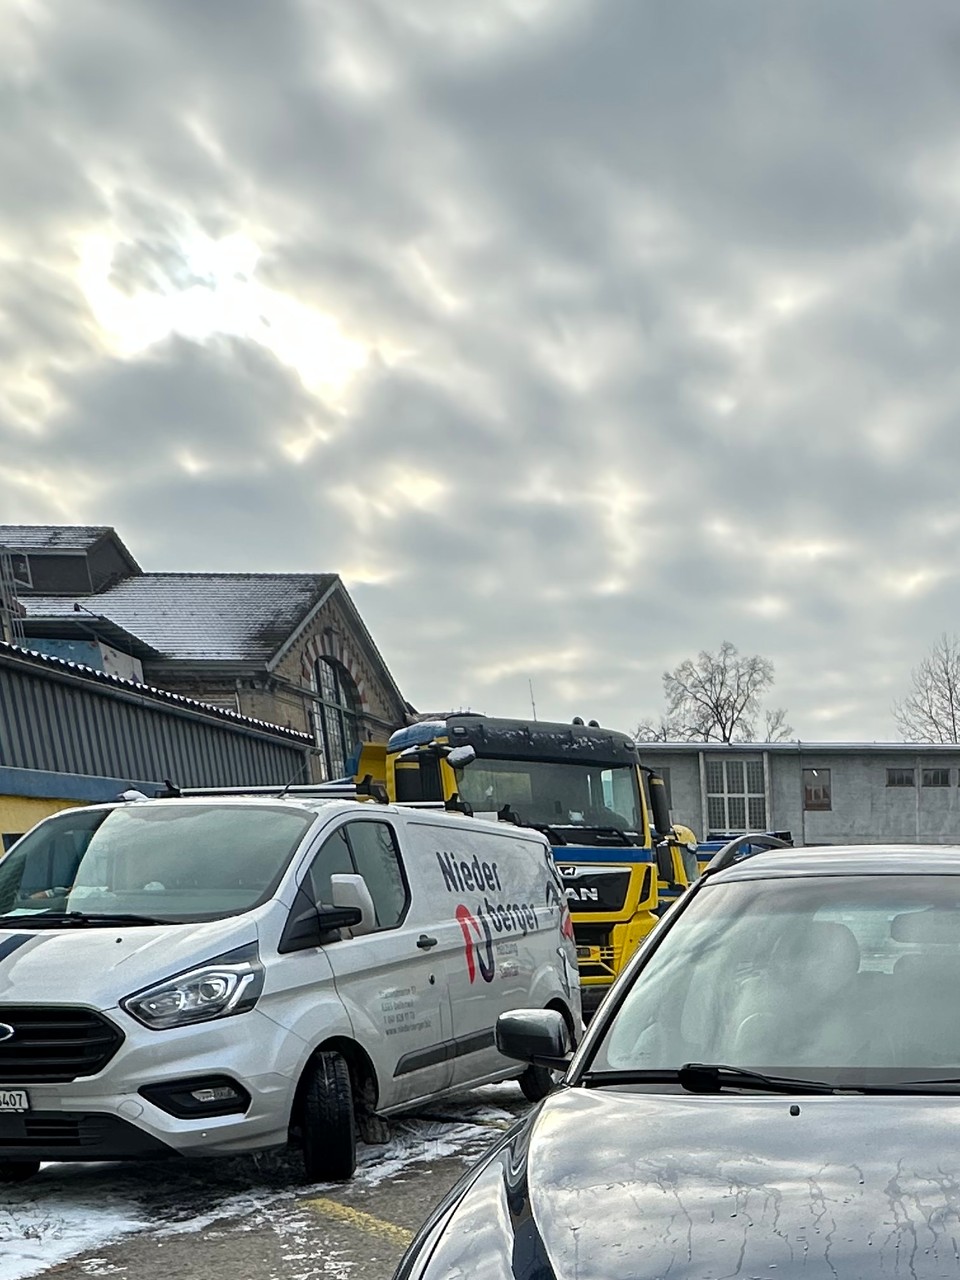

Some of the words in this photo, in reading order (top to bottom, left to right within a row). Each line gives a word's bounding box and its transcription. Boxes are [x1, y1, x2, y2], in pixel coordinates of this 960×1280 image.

[436, 852, 502, 892] Nieder
[562, 887, 599, 901] AN
[484, 897, 540, 937] berger
[0, 1093, 23, 1107] 407
